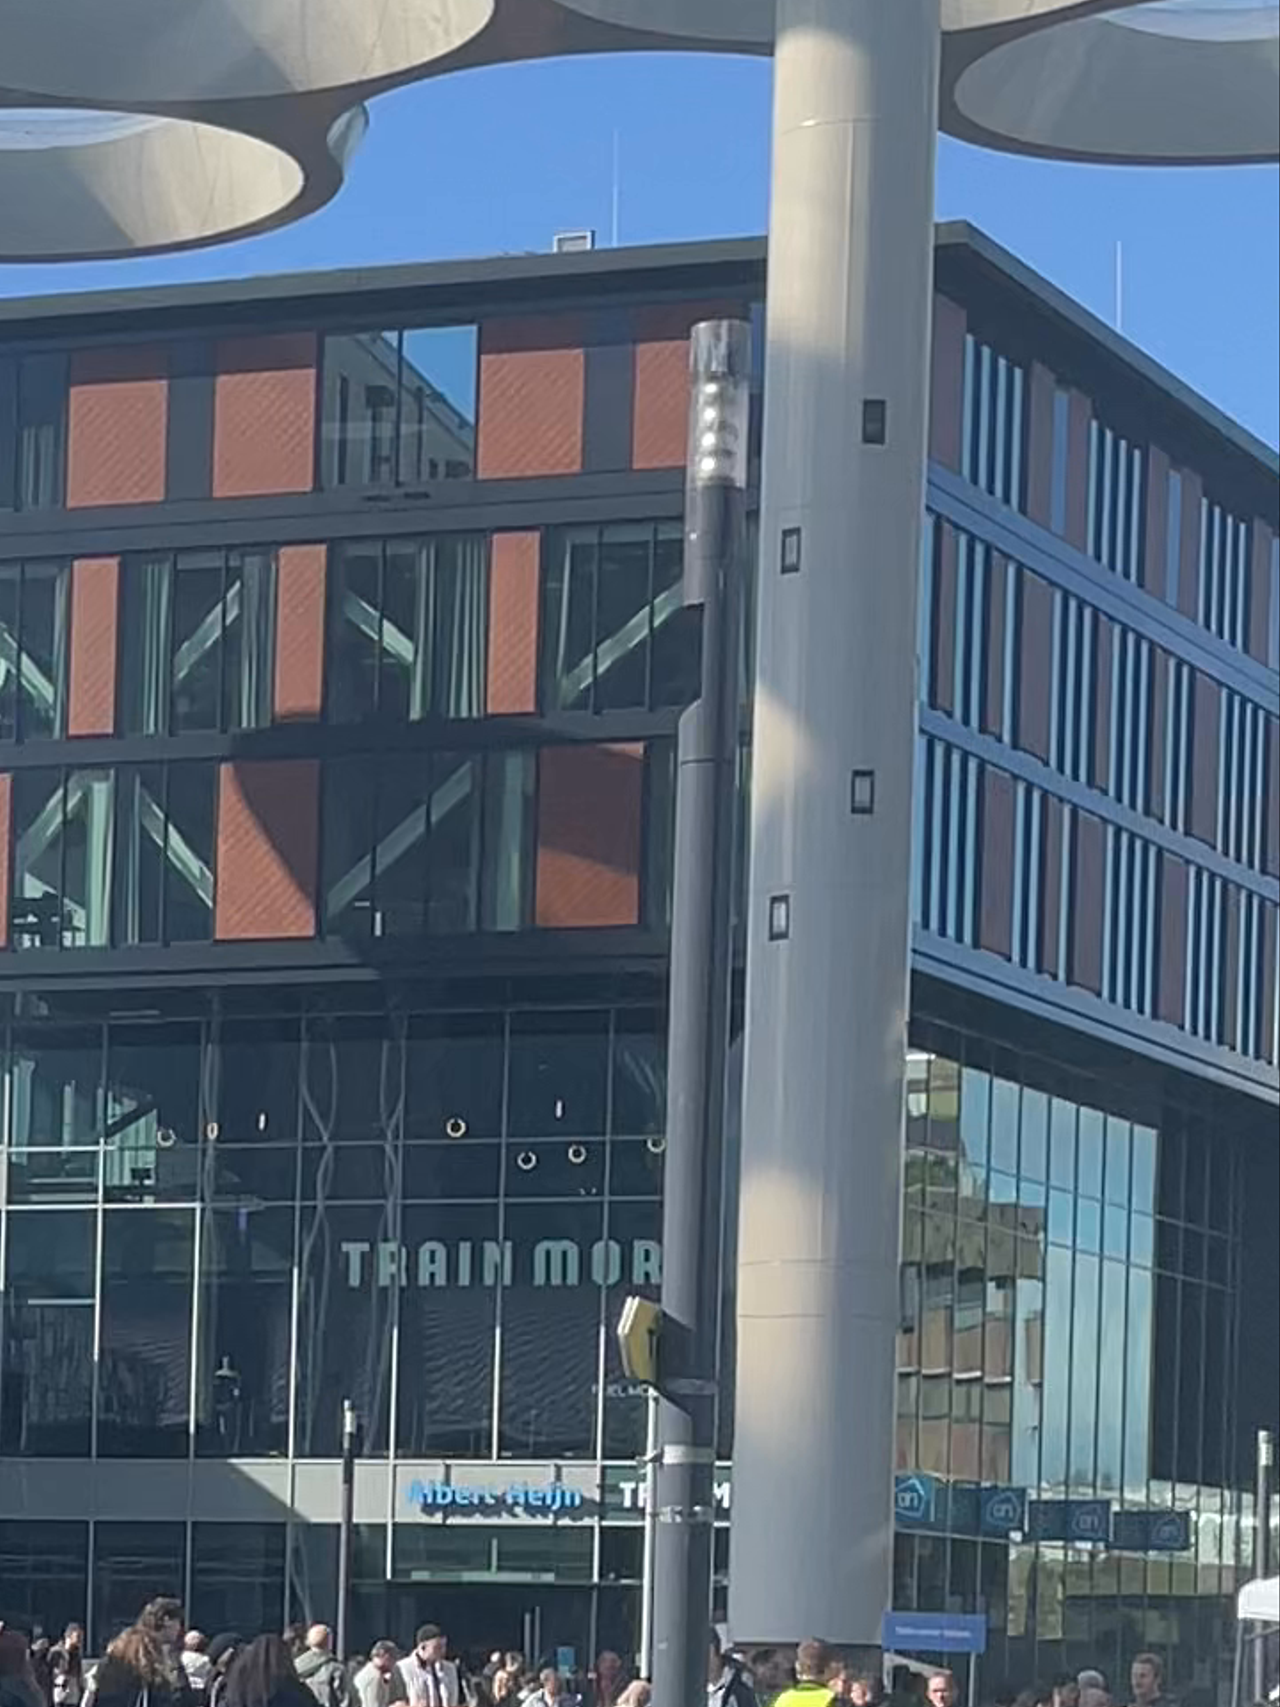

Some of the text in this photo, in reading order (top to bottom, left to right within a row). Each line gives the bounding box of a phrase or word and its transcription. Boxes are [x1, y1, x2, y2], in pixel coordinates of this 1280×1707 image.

[341, 1240, 662, 1287] TRAIN MOR
[406, 1478, 583, 1510] Albert Heijn
